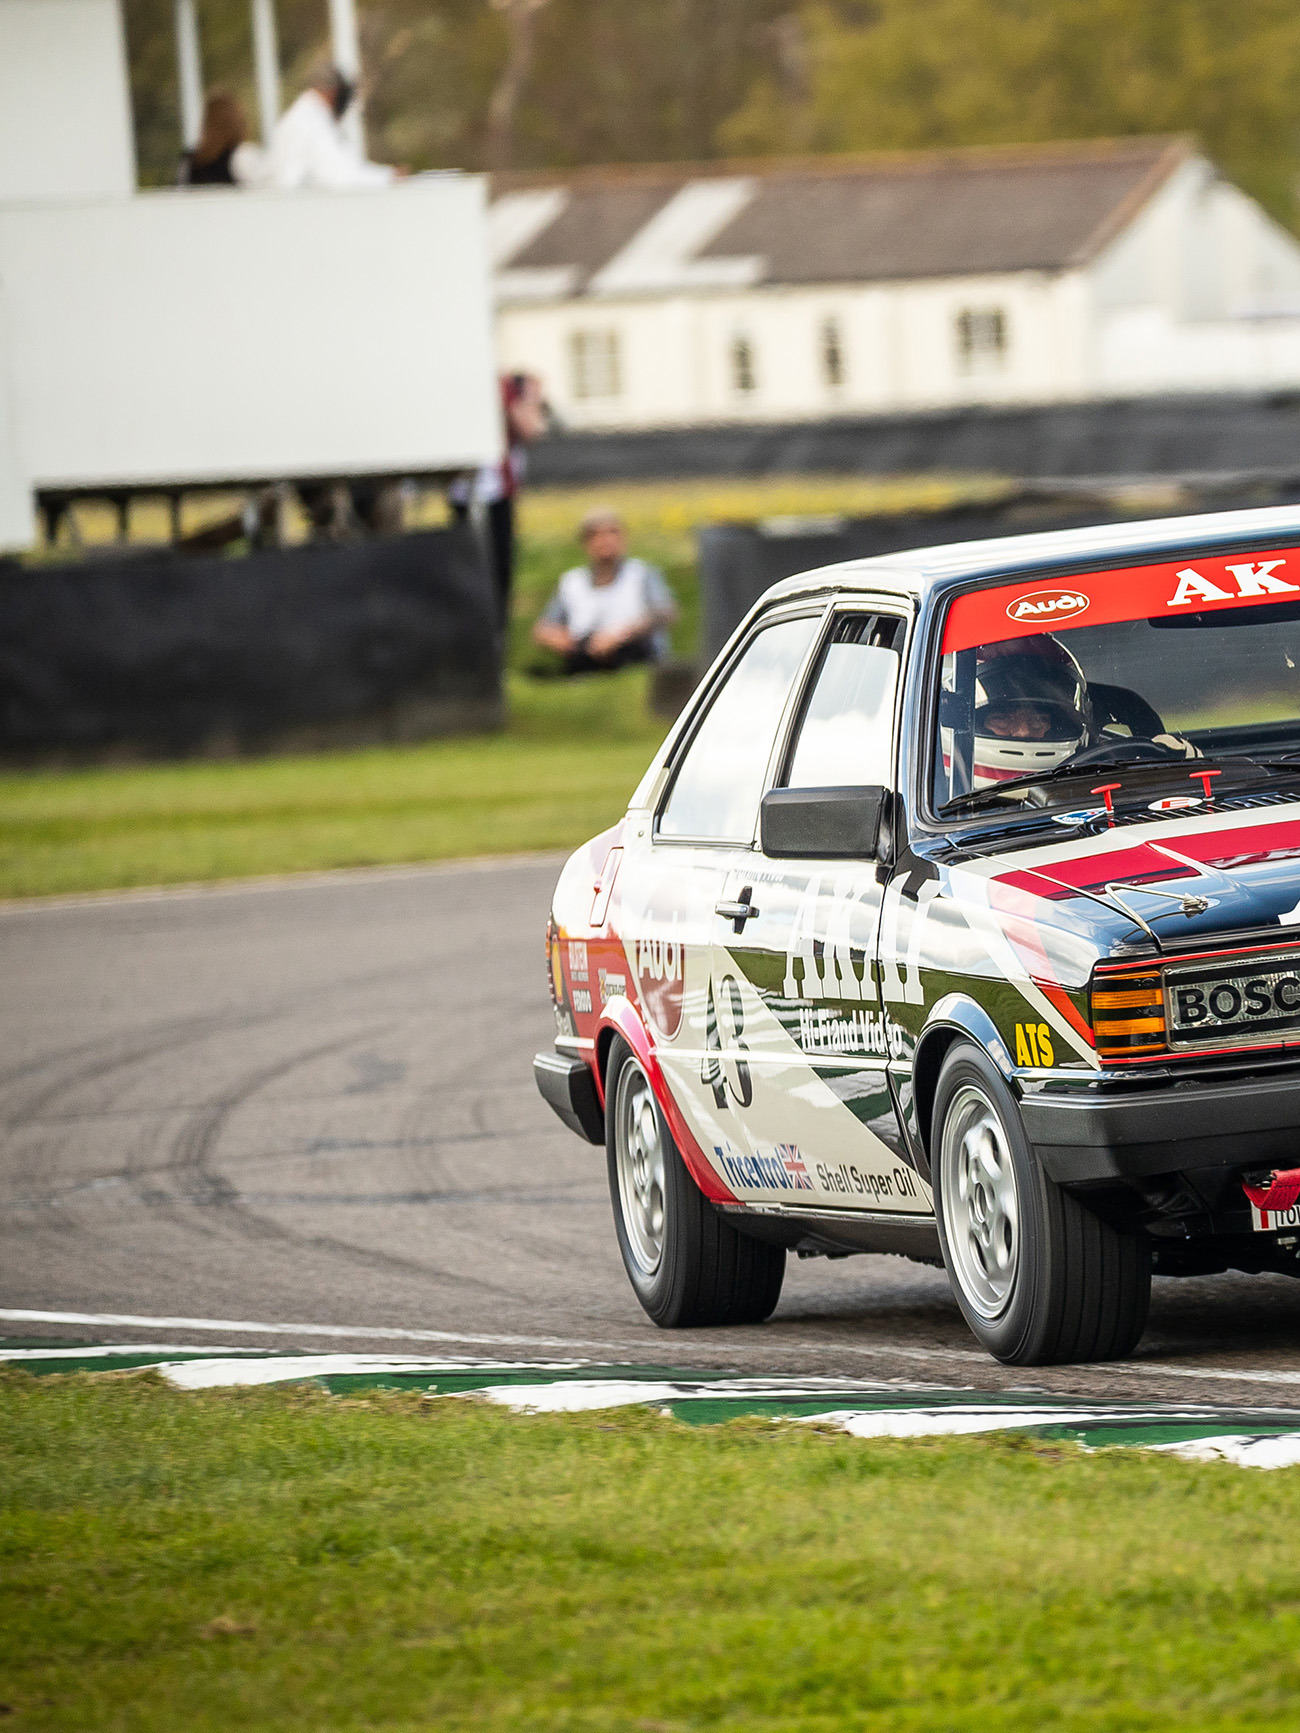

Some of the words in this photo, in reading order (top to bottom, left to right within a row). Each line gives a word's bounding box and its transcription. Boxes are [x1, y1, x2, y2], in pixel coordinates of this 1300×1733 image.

[1013, 595, 1087, 618] Audi
[783, 869, 947, 1005] AKAI
[701, 972, 754, 1109] 43
[800, 1008, 830, 1050] Hi-Fi
[831, 1010, 858, 1052] and
[859, 1010, 902, 1055] Video
[1015, 1023, 1054, 1067] ATS
[713, 1140, 793, 1190] Tricentrol
[816, 1164, 853, 1193] Shell
[850, 1165, 893, 1203] Super
[893, 1168, 917, 1197] Oil
